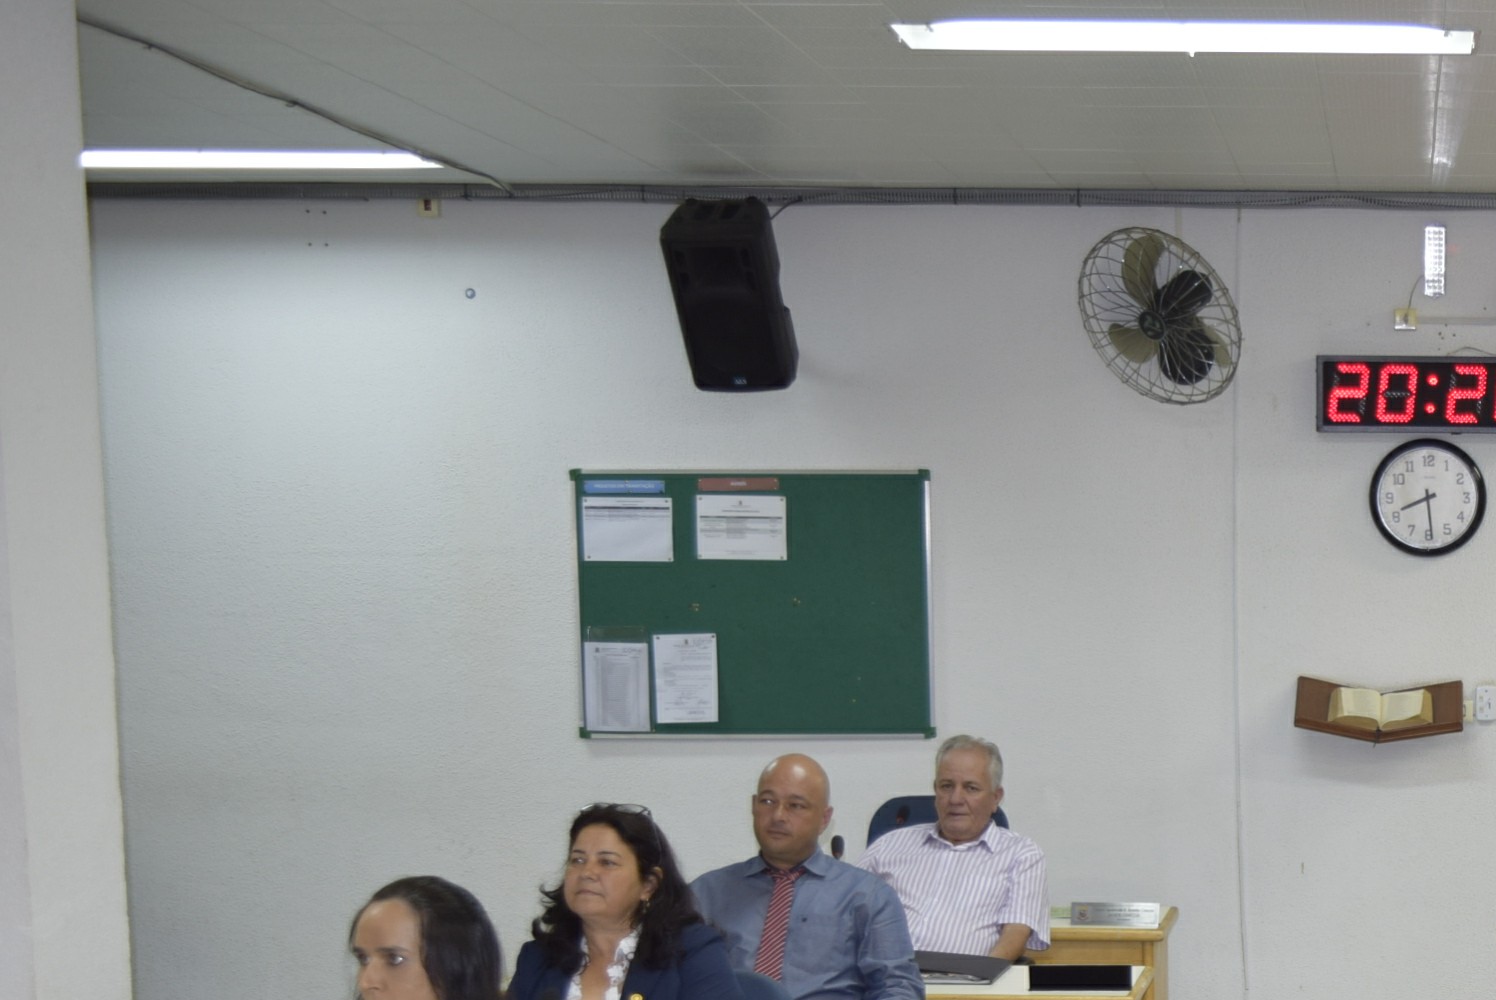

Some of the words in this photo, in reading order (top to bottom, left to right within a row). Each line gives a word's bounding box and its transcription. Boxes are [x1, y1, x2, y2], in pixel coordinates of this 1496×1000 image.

[1405, 460, 1414, 472] 11
[1422, 455, 1435, 467] 12
[1445, 460, 1449, 472] 1
[1393, 473, 1405, 485] 10
[1456, 473, 1464, 485] 2
[1385, 492, 1394, 504] 9
[1463, 492, 1471, 504] 3
[1392, 511, 1400, 523] 8
[1456, 511, 1465, 523] 4
[1407, 524, 1416, 536] 7
[1443, 523, 1452, 536] 5
